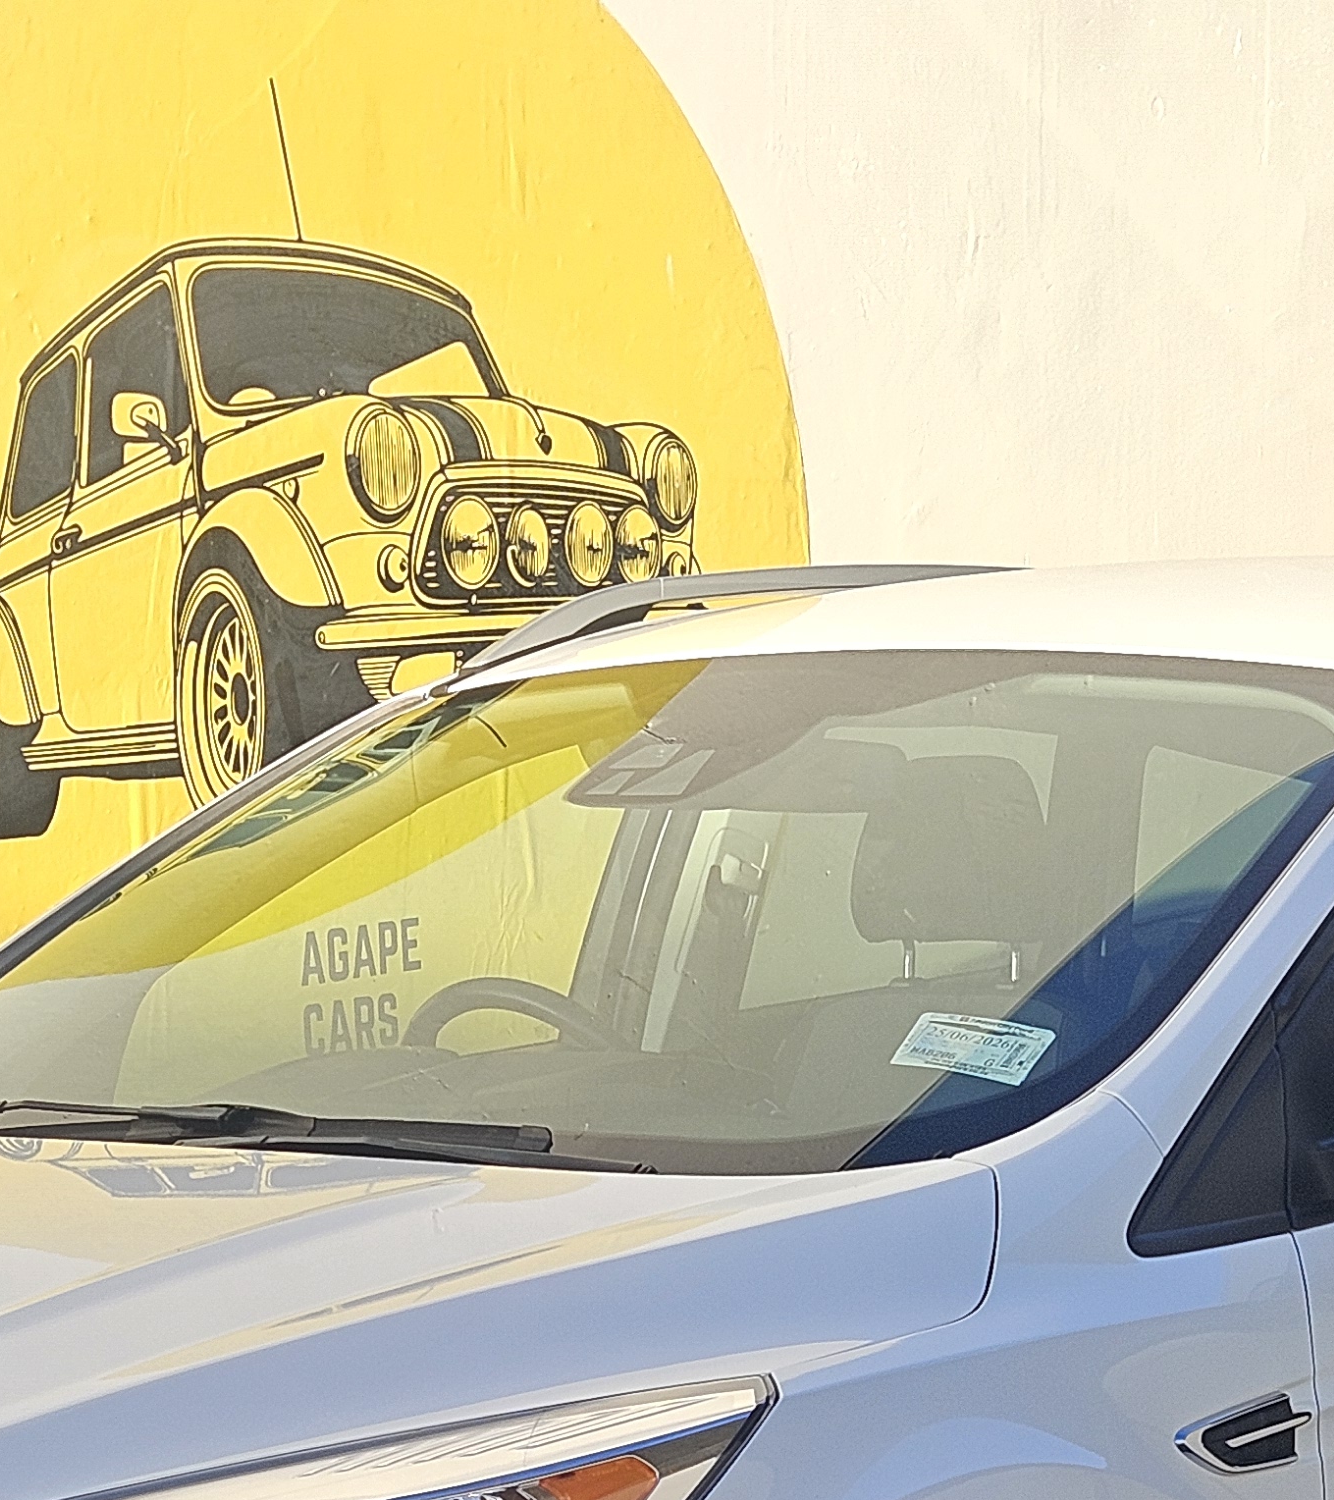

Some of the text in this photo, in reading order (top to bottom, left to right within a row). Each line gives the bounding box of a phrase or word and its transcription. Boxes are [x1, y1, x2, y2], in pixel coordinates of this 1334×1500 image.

[301, 917, 422, 986] AGAPE
[303, 992, 399, 1057] CARS
[926, 1026, 1011, 1050] 25/06/2026
